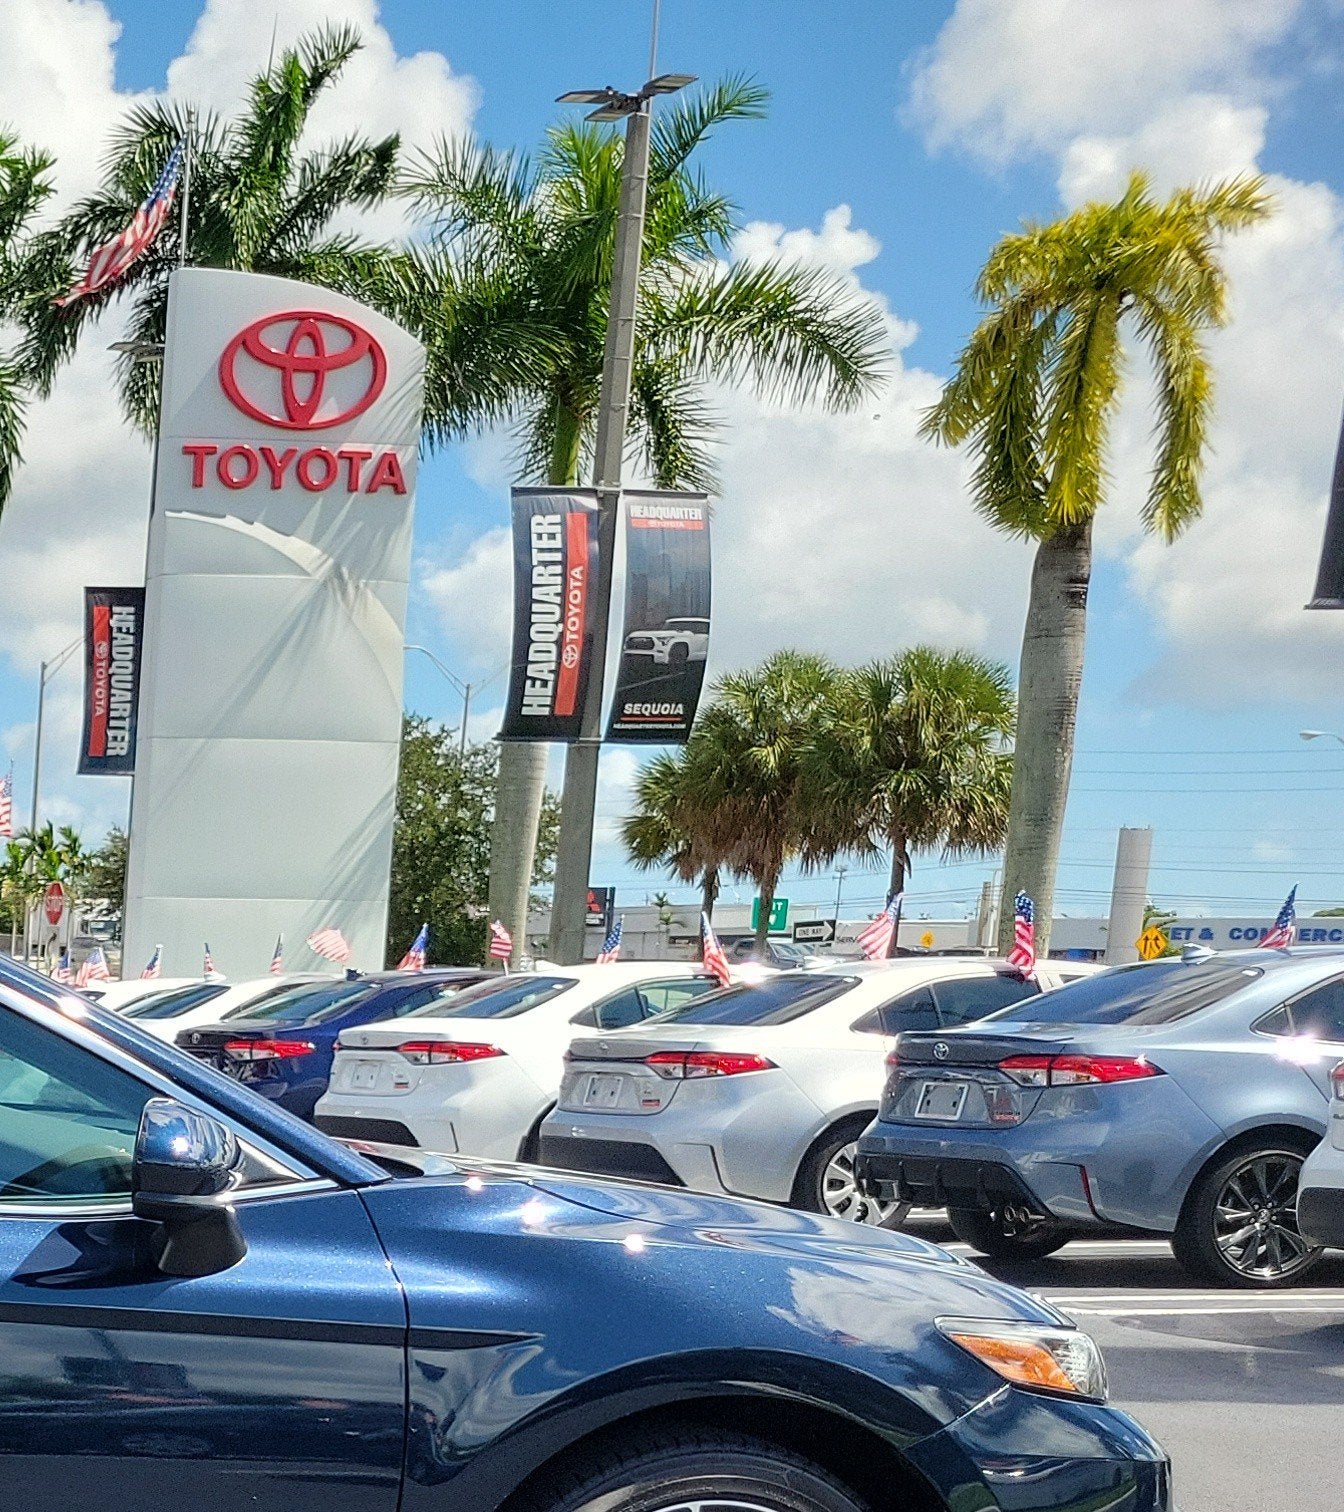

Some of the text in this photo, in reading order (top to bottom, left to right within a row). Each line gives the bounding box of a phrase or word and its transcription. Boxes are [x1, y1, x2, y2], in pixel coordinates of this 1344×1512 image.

[182, 446, 407, 495] TOYOTA
[521, 514, 564, 716] HEADQUARTER
[565, 565, 585, 641] TOYOTA
[94, 660, 107, 717] TOYOTA
[106, 606, 135, 756] HEADQUARTER
[623, 703, 684, 716] SEQUOIA
[1198, 927, 1214, 940] &
[1229, 927, 1342, 942] COERC
